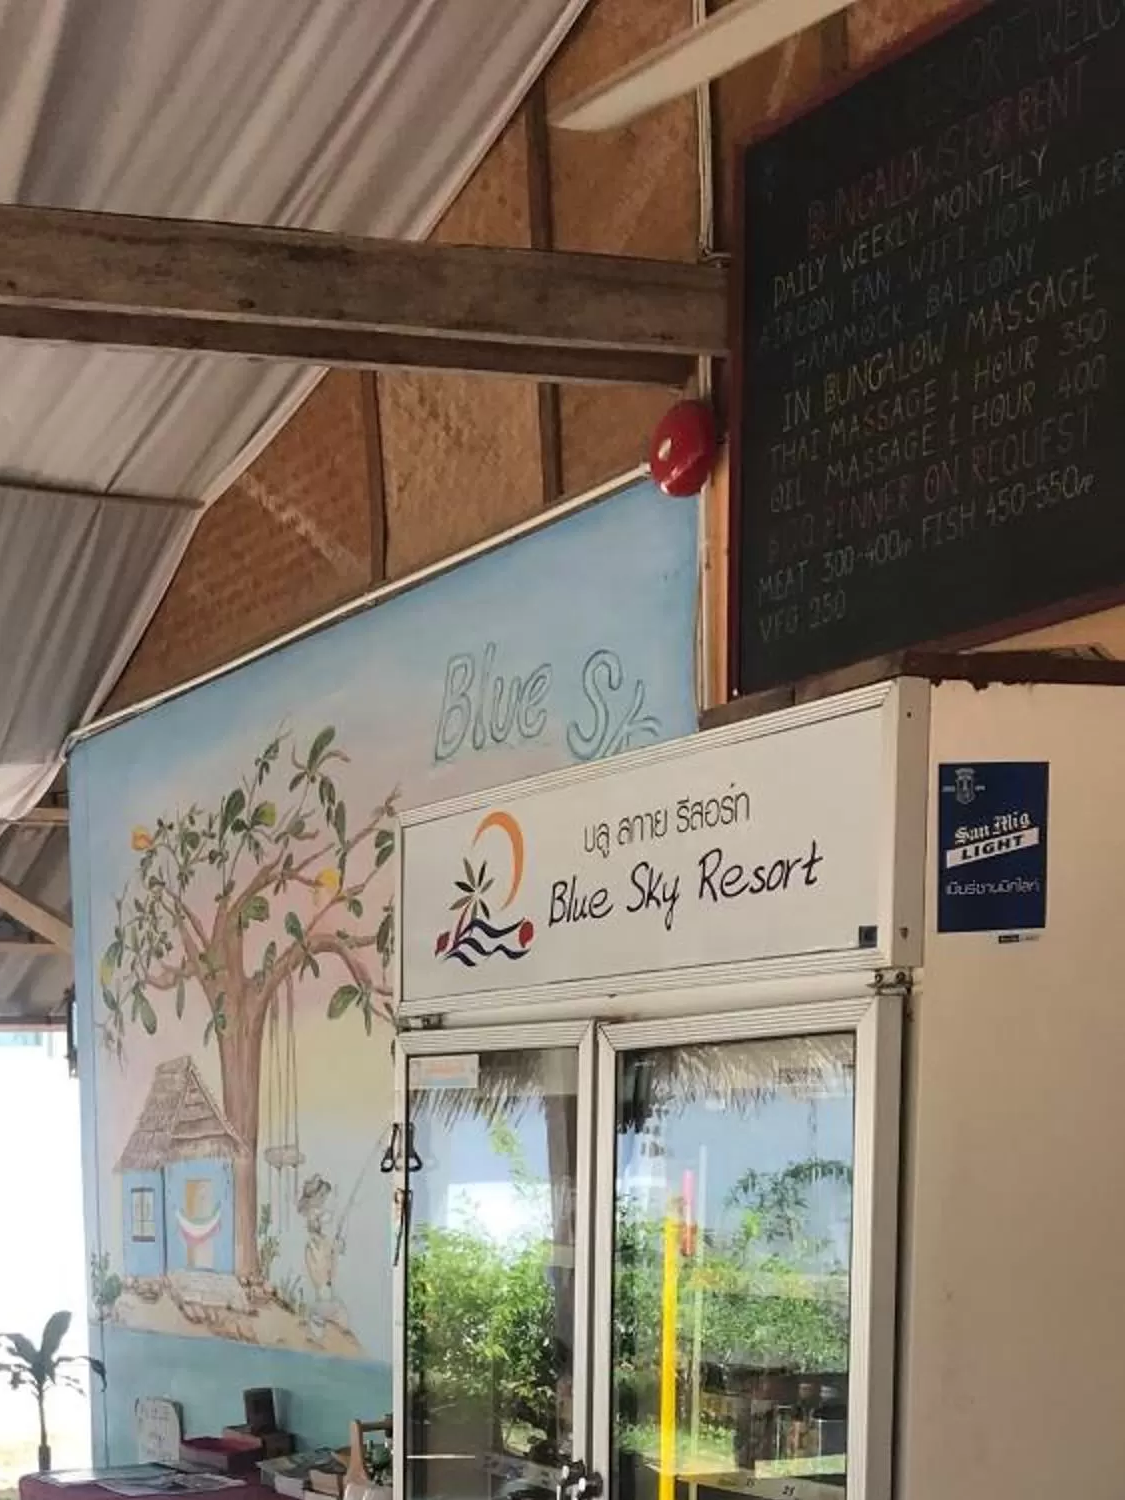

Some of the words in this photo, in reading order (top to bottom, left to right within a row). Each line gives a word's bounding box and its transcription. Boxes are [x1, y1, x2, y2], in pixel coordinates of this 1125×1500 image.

[773, 254, 827, 312] DAILY
[932, 141, 1049, 229] MONTHLY
[782, 386, 810, 432] IN
[824, 324, 948, 412] BUNGALOW
[965, 251, 1100, 352] MASSAGE
[770, 429, 822, 475] THAI
[828, 379, 938, 453] MASSAGE
[974, 336, 1040, 392] HOUR
[770, 477, 806, 513] OIL
[825, 422, 937, 494] MASSAGE
[971, 380, 1036, 437] HOUR
[1055, 353, 1107, 400] 400
[924, 454, 960, 504] ON
[973, 404, 1093, 484] REQUEST
[755, 560, 809, 608] MEAT
[922, 500, 976, 551] FISH
[433, 641, 554, 763] Blue
[584, 823, 611, 858] บลู
[616, 809, 668, 846] สกาย
[676, 782, 750, 833] รีสอร์ท
[954, 824, 991, 846] San
[992, 810, 1031, 836] Mig
[961, 834, 1025, 861] LIGHT
[548, 874, 614, 928] Blue
[626, 861, 680, 931] Sky
[698, 839, 823, 902] Resort
